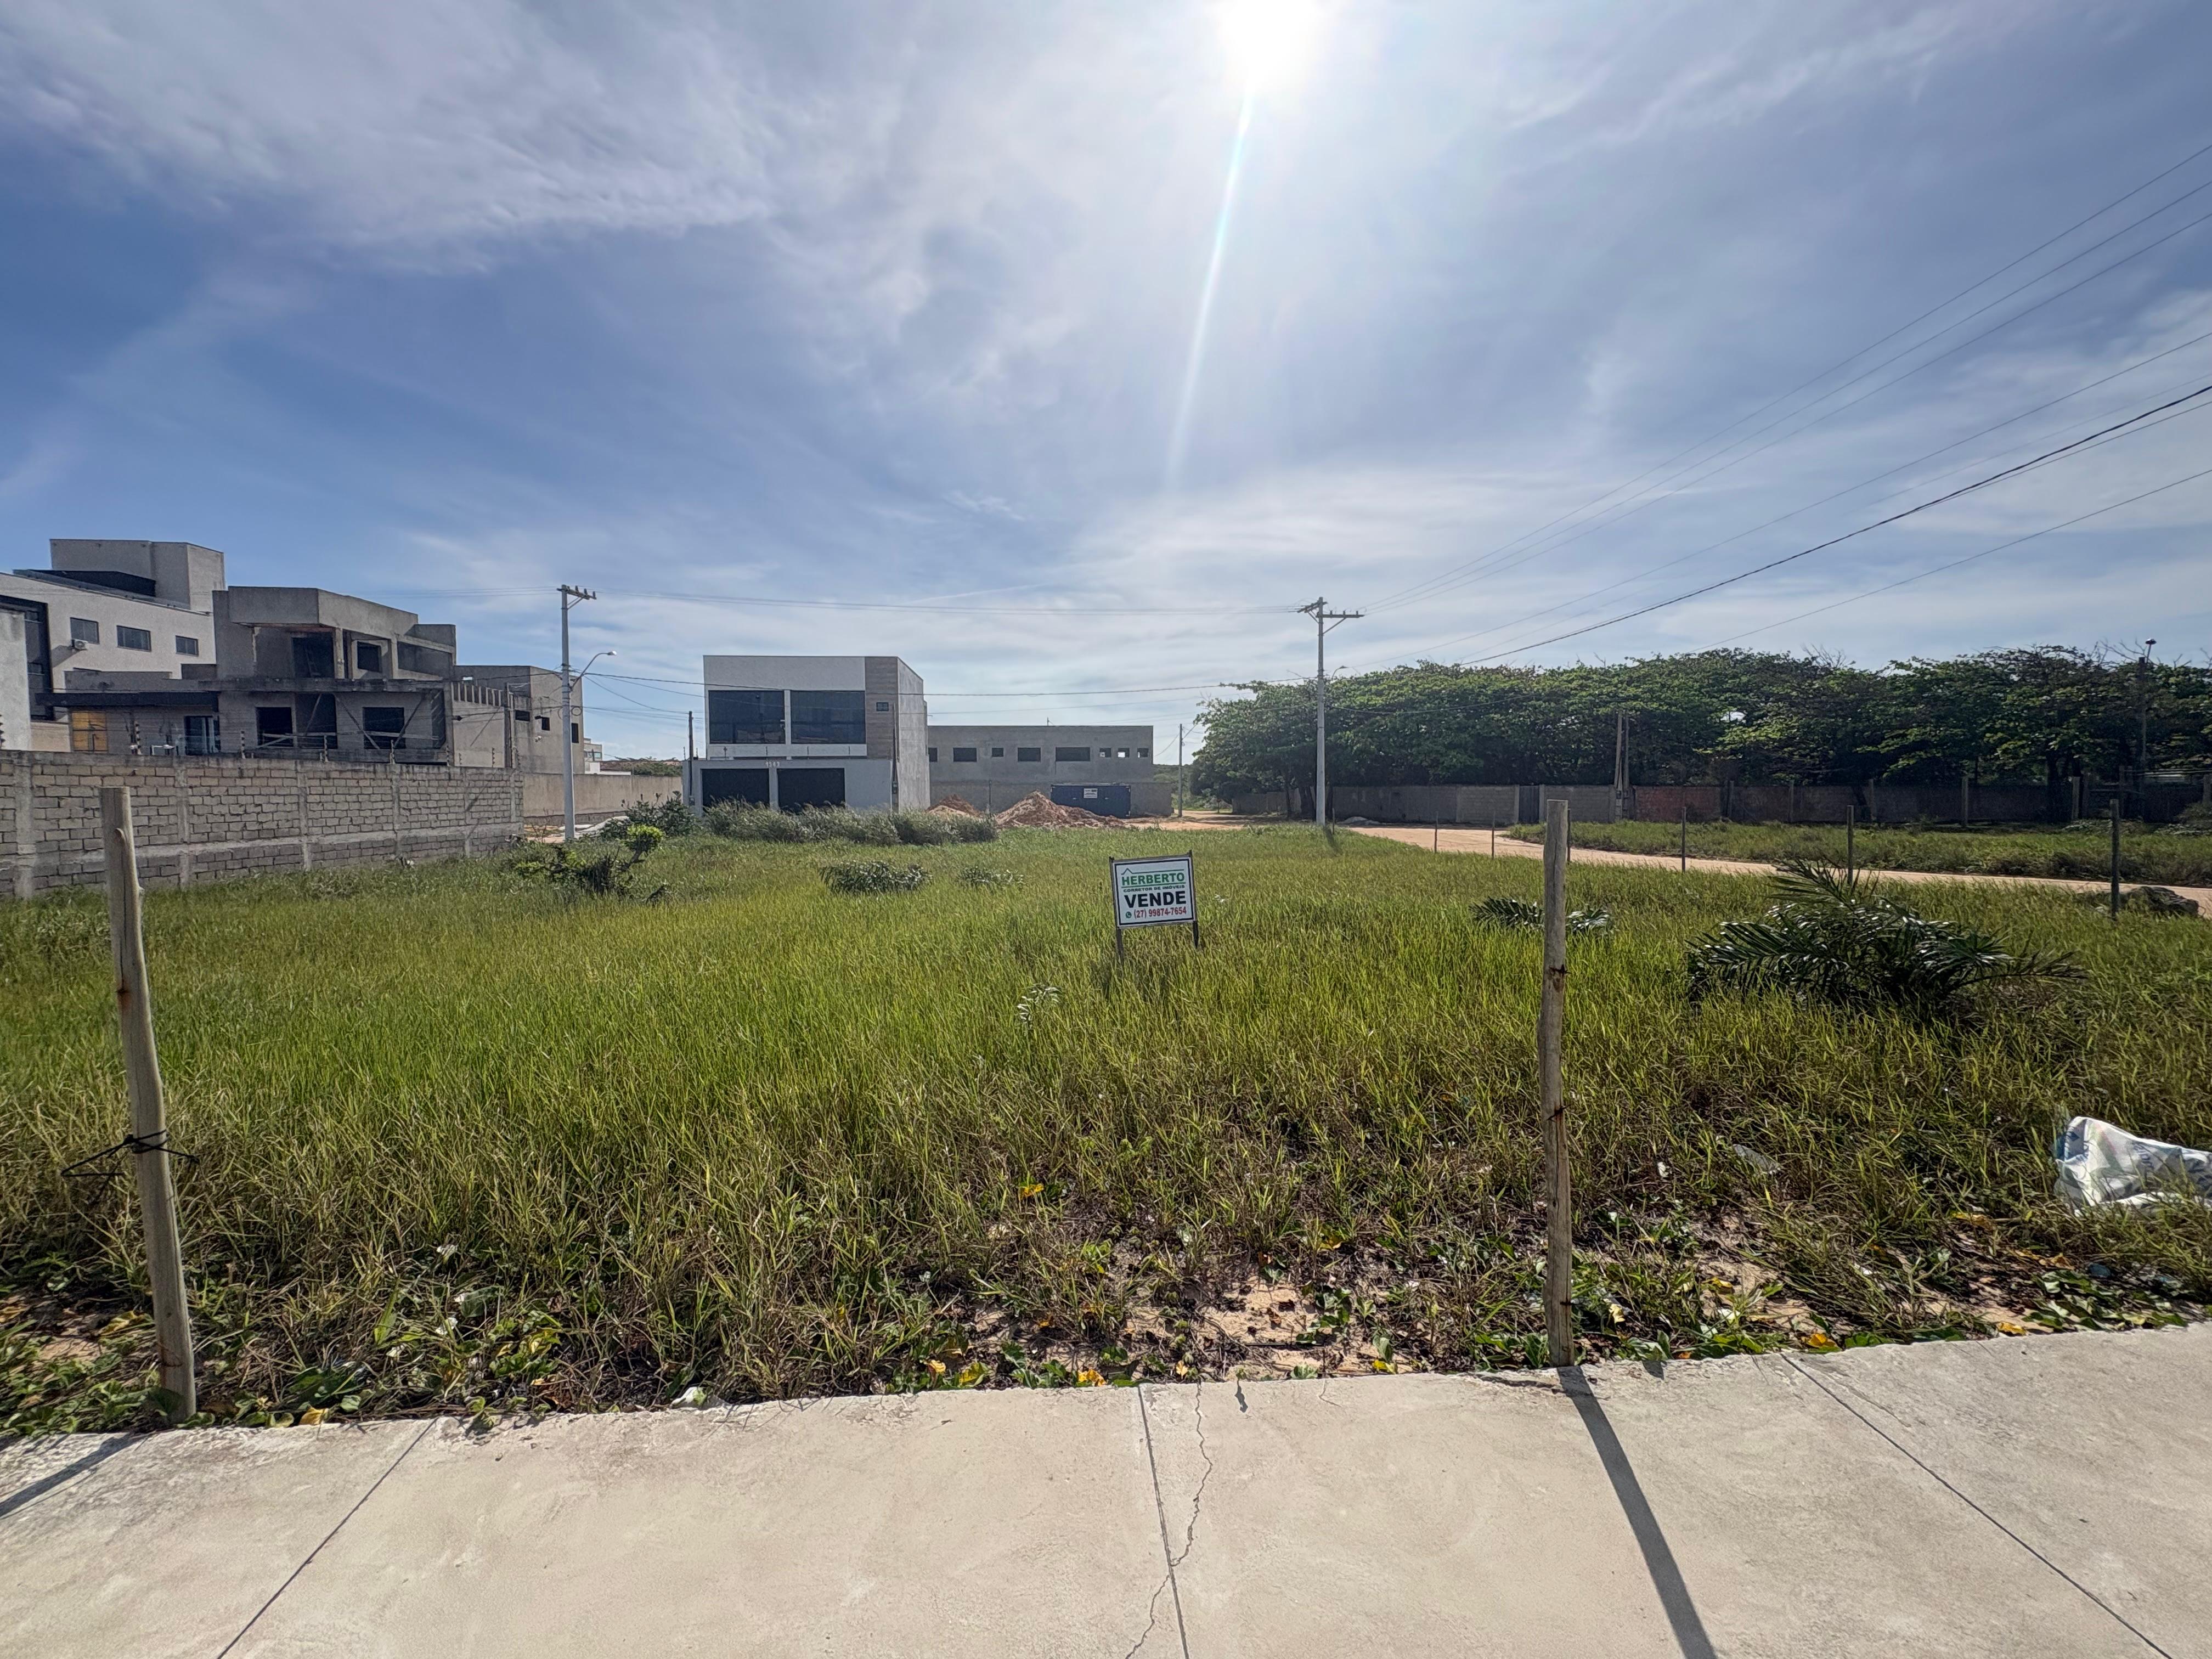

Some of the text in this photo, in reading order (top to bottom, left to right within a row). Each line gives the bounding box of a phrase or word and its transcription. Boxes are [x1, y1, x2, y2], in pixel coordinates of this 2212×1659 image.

[1122, 873, 1184, 885] HERBERTO
[1124, 891, 1186, 908] VENDE
[1134, 906, 1187, 919] (27) 99874-7654
